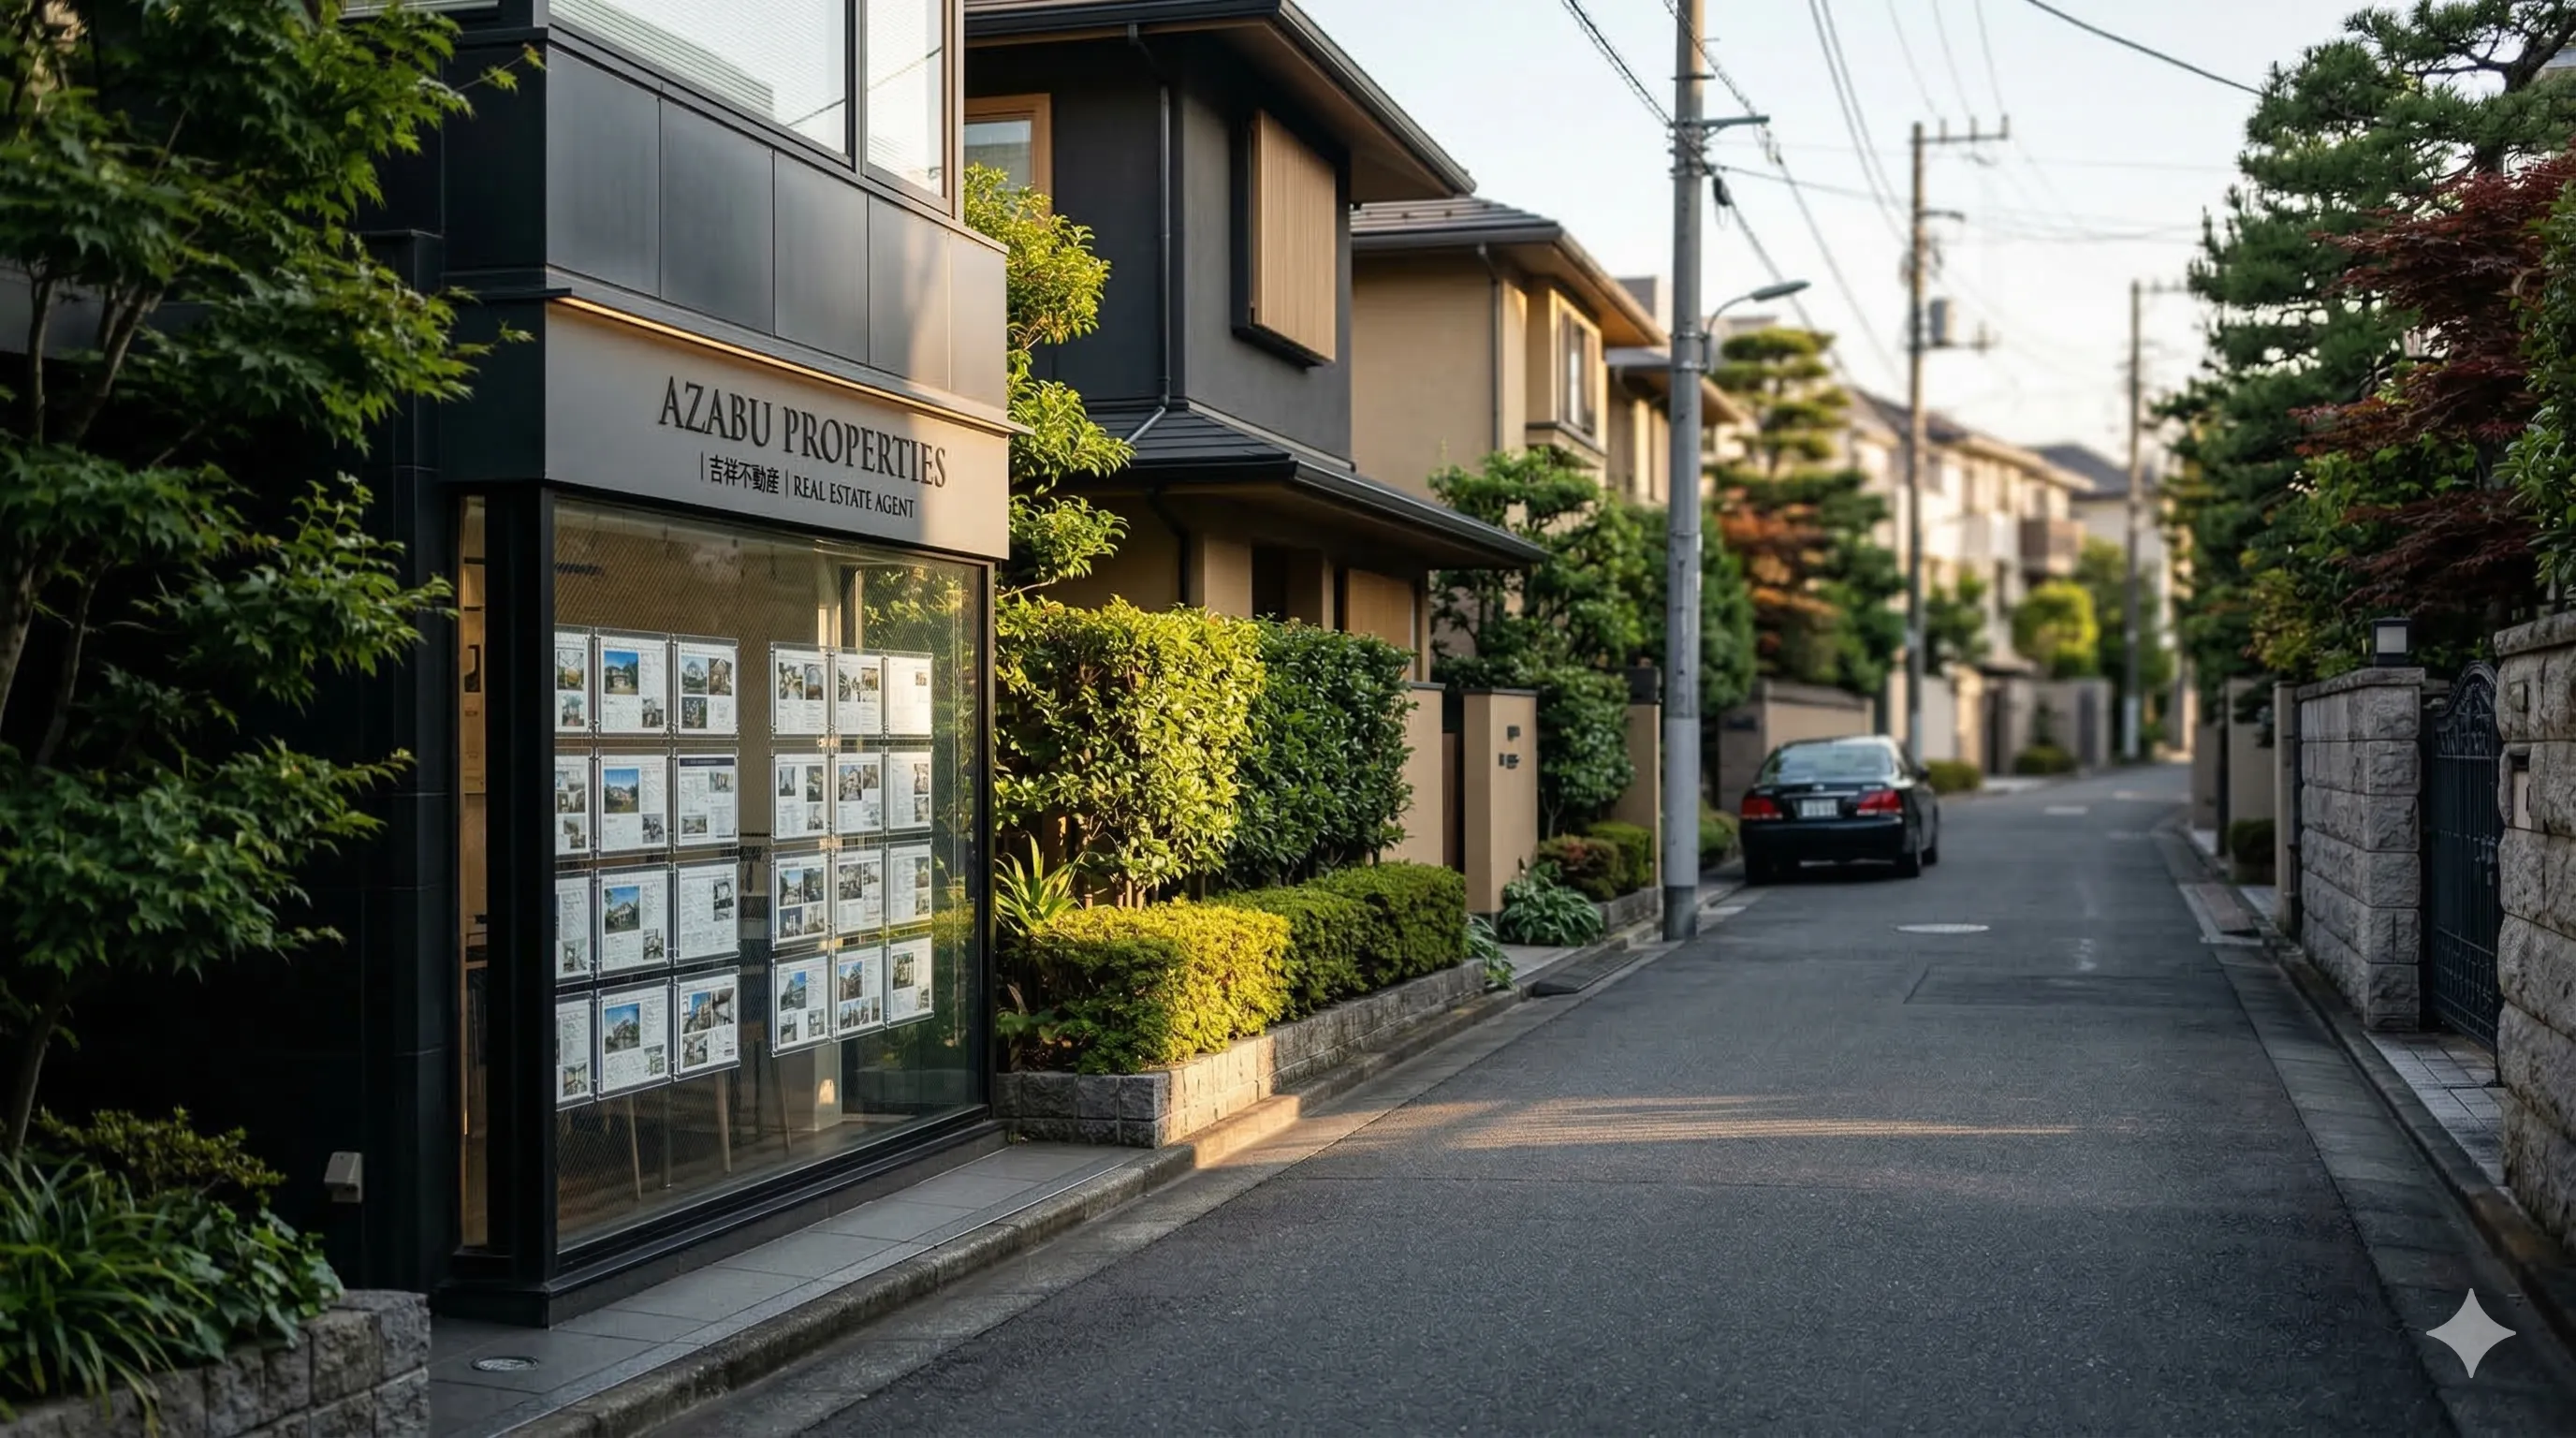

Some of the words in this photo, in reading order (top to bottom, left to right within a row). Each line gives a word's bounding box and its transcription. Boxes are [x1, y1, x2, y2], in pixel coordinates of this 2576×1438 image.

[658, 375, 772, 448] AZABU
[783, 406, 946, 488] PROPERTIES
[709, 454, 779, 494] 吉祥不動産
[794, 475, 826, 501] REAL
[830, 482, 871, 510] ESTATE
[875, 493, 914, 518] AGENT
